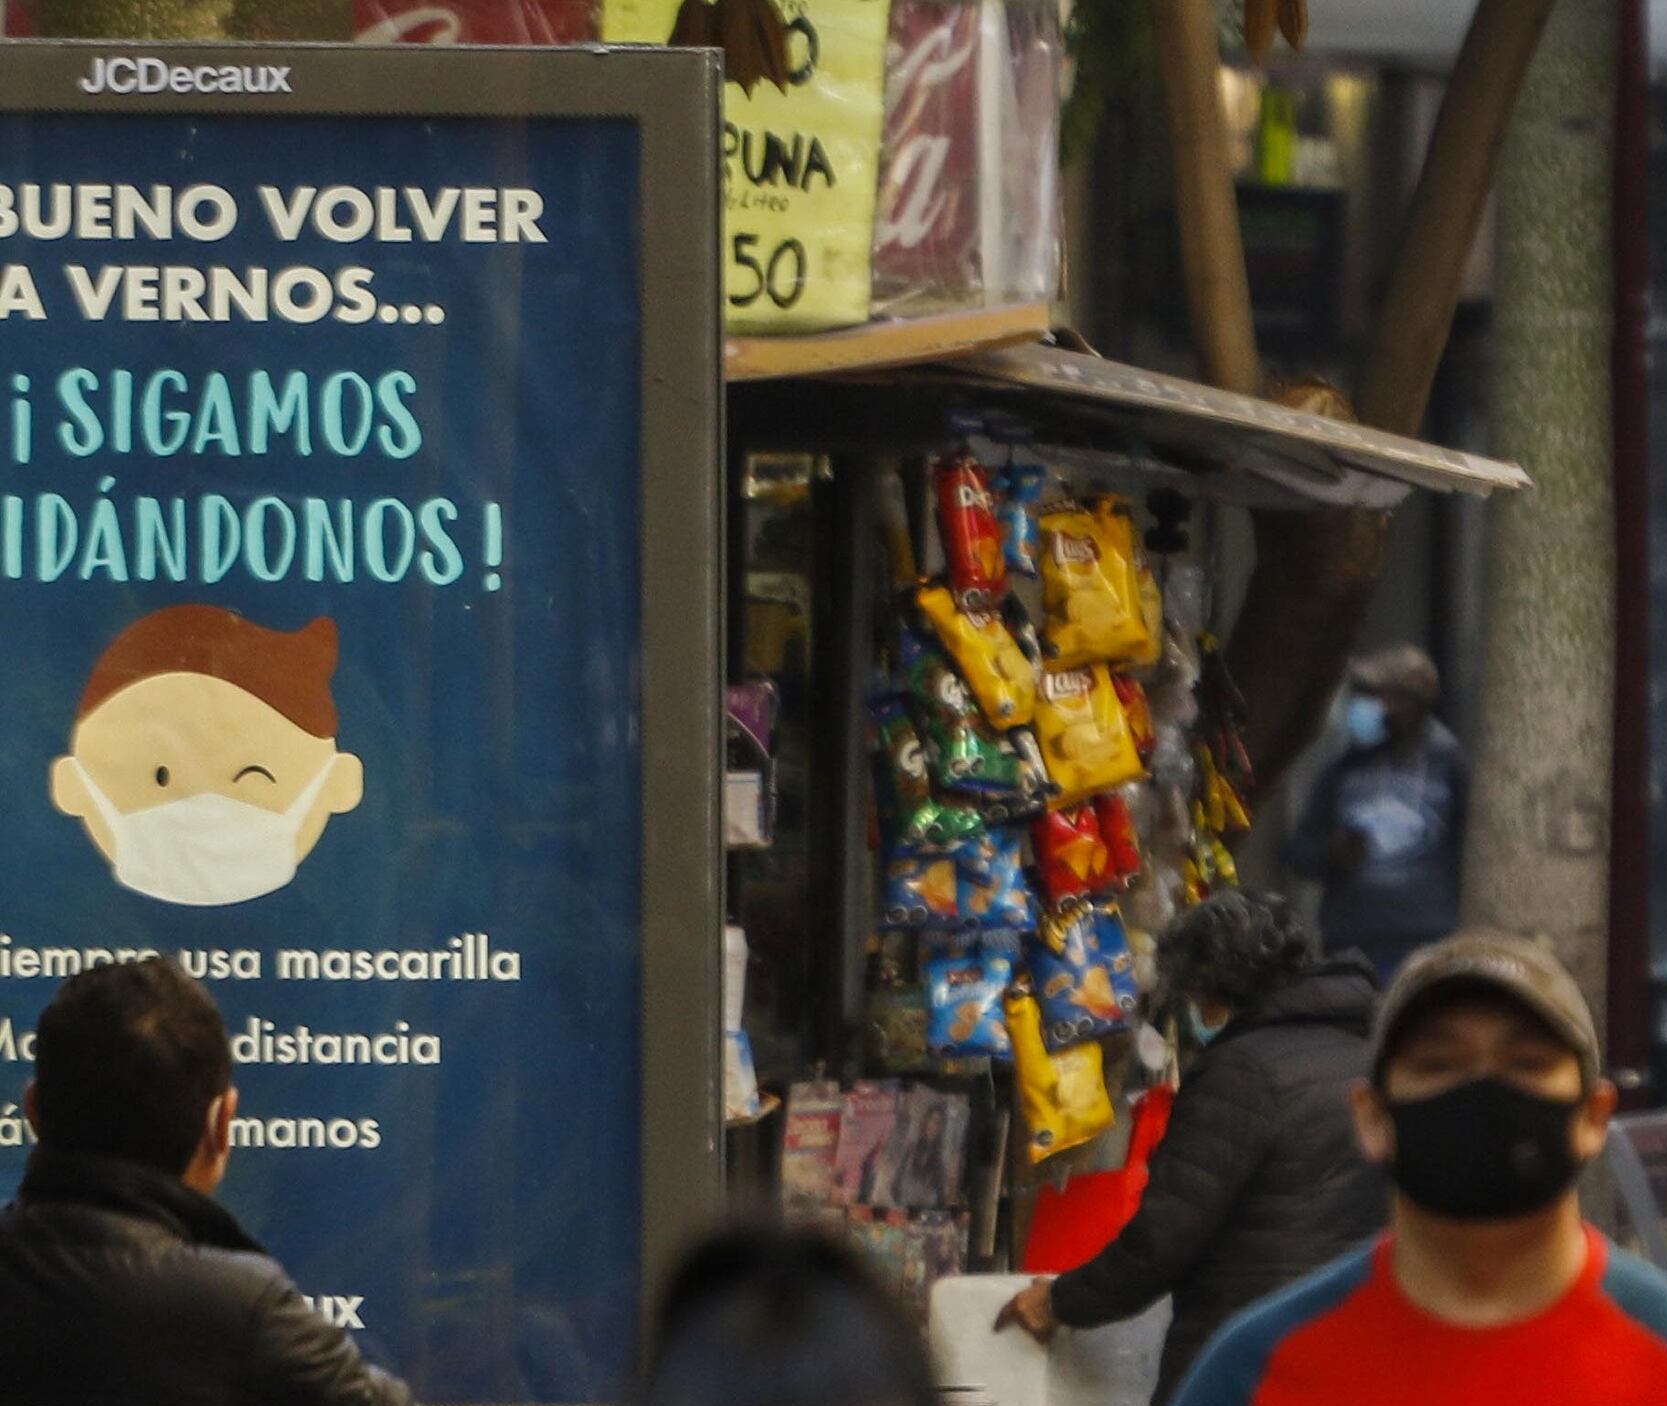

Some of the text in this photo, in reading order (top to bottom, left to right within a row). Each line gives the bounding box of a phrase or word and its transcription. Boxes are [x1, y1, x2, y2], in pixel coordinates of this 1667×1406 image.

[80, 57, 292, 95] JCDecaux
[0, 183, 548, 243] BUENO VOLVER
[0, 264, 446, 325] A VERNOS...
[3, 474, 503, 591] IDÁNDONOS!
[179, 949, 262, 980] usa
[276, 933, 521, 982] mascarilla
[231, 1016, 441, 1065] distancia
[229, 1116, 381, 1149] manos
